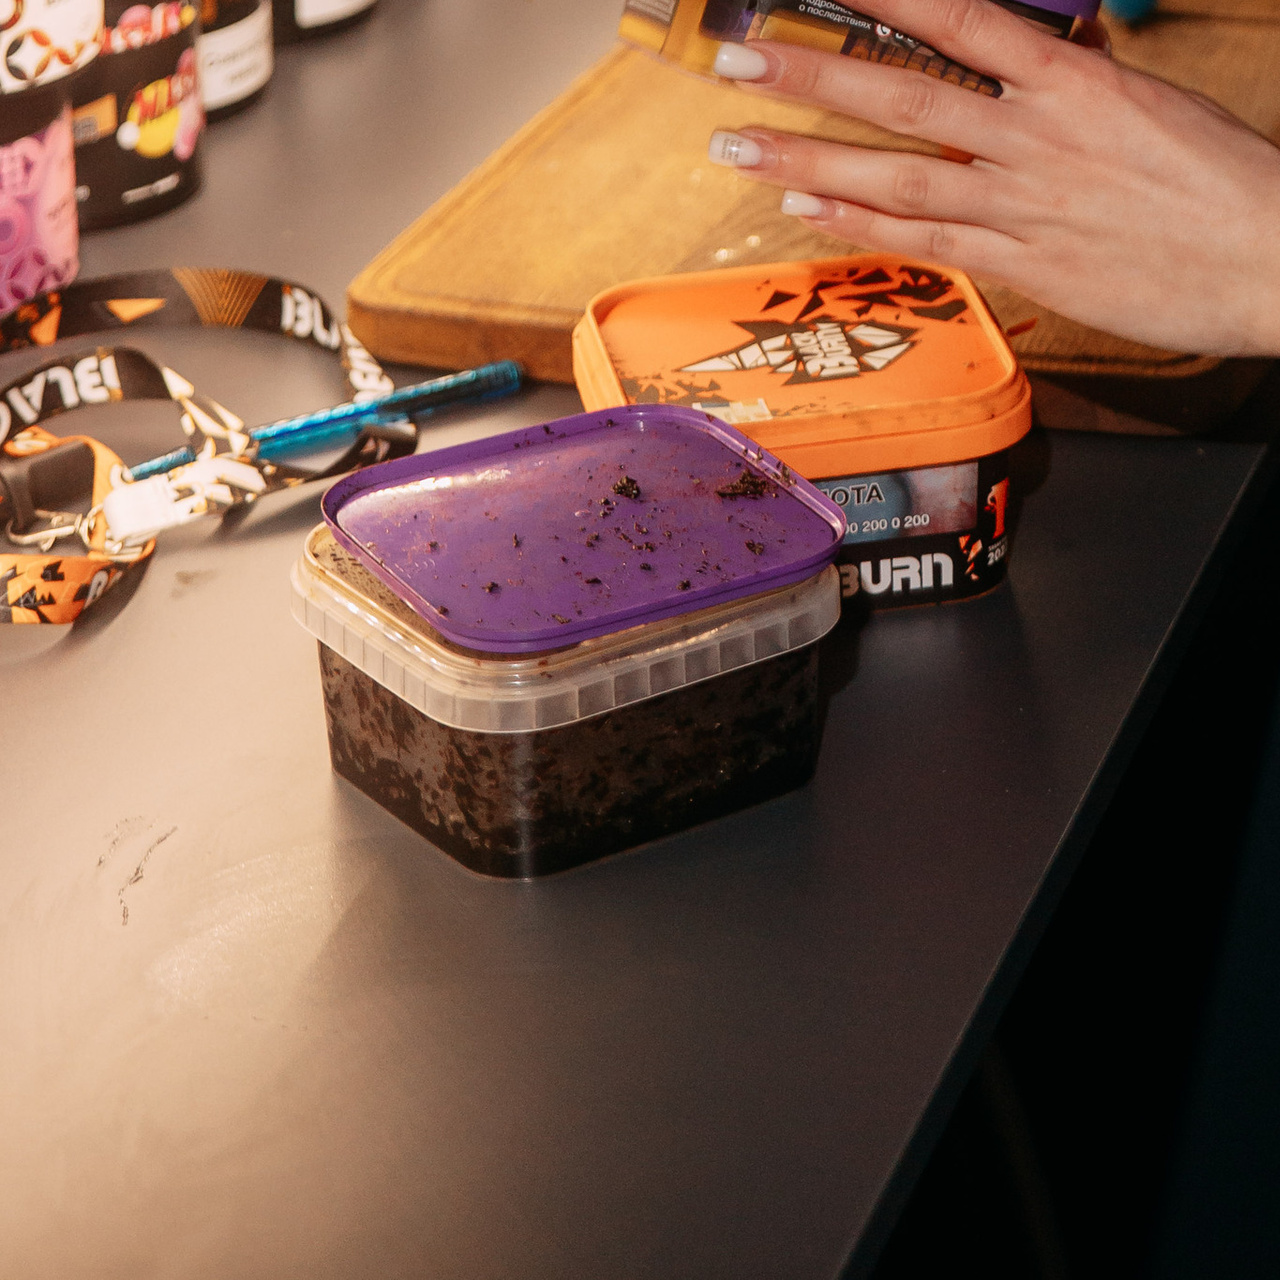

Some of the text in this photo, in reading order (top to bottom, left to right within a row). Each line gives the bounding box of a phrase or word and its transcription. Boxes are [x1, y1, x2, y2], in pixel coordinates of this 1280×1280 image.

[807, 5, 872, 30] последствиях
[821, 482, 886, 507] ОТА
[862, 519, 888, 532] 200
[904, 513, 930, 528] 200
